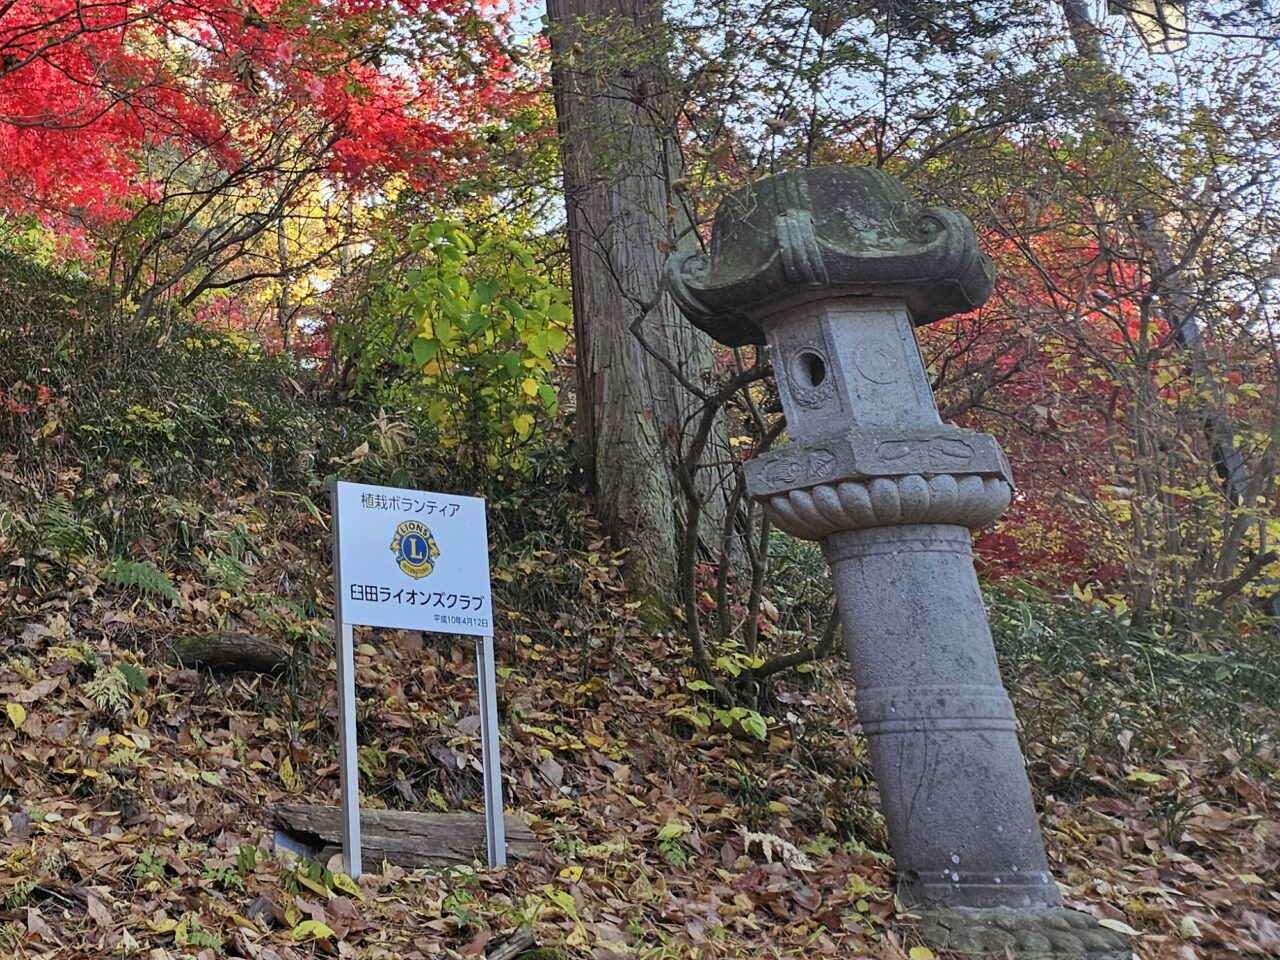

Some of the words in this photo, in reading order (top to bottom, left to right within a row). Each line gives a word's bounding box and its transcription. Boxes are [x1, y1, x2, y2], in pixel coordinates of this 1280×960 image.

[361, 492, 460, 517] 植栽ボランティア
[400, 522, 429, 537] LIONS
[410, 538, 423, 559] L
[350, 584, 484, 611] 臼田ライオンズクラブ
[433, 614, 488, 628] 平成10年4月12日
